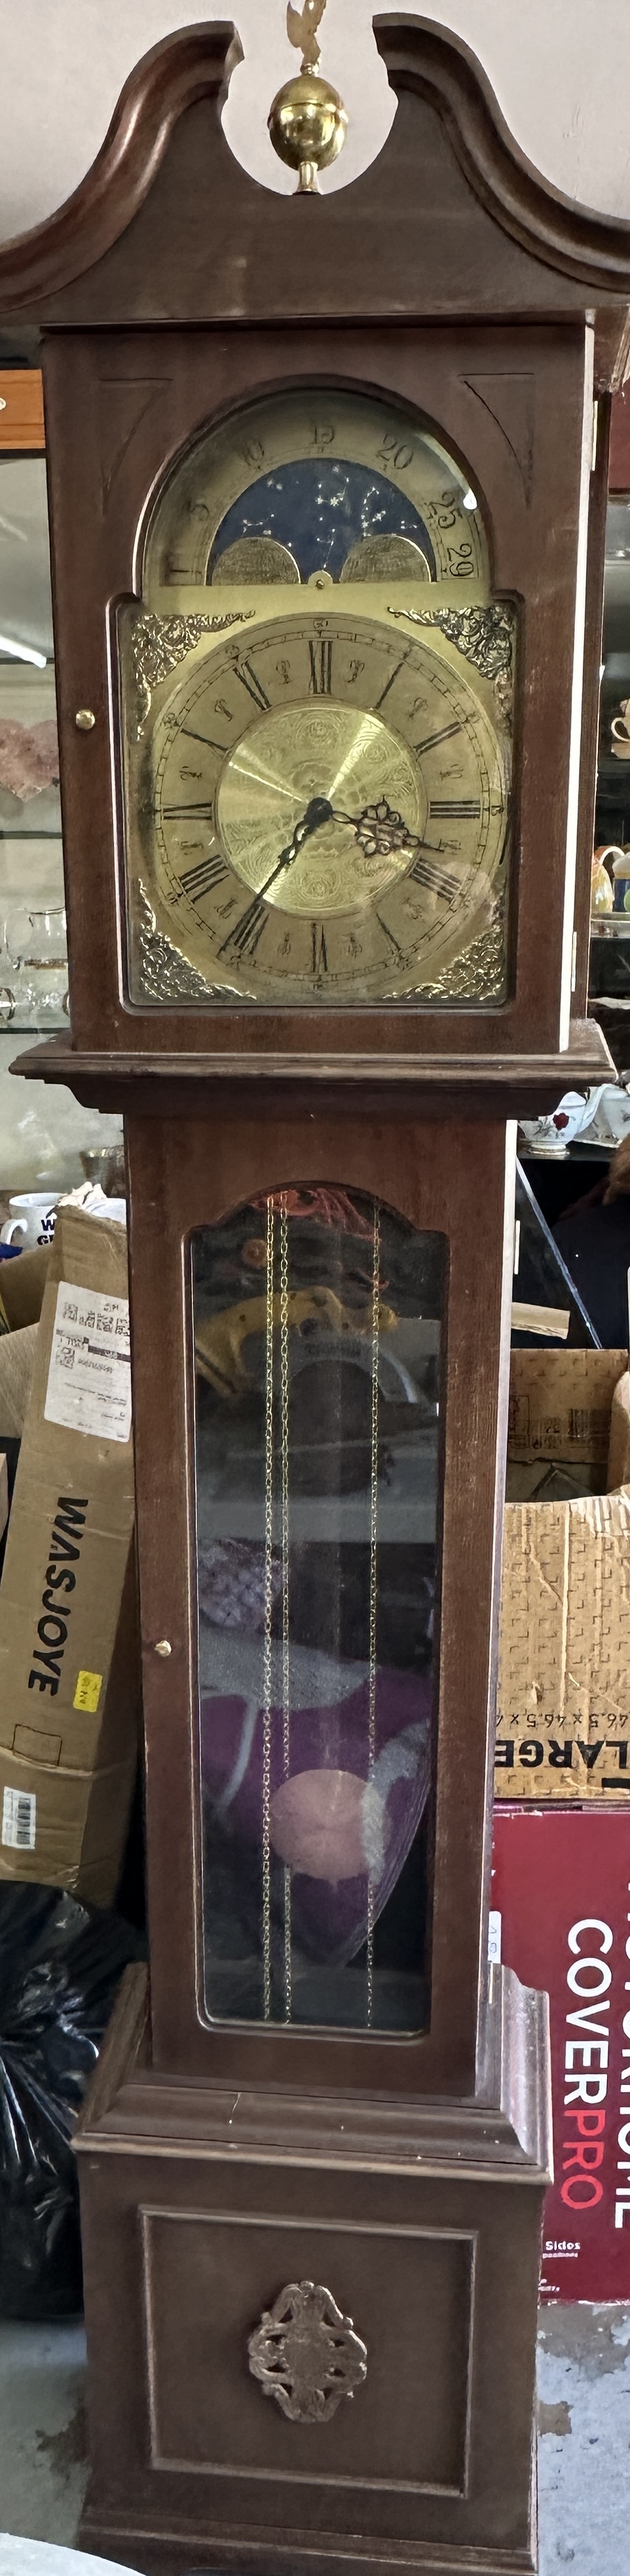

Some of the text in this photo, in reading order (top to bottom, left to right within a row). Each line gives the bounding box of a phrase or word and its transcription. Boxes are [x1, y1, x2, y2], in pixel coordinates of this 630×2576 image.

[377, 433, 415, 470] 20
[429, 490, 464, 529] 25
[28, 1497, 89, 1697] WASJOYE
[527, 1713, 567, 1729] 46.5
[589, 1713, 629, 1729] 46.5
[494, 1740, 629, 1769] LARGE
